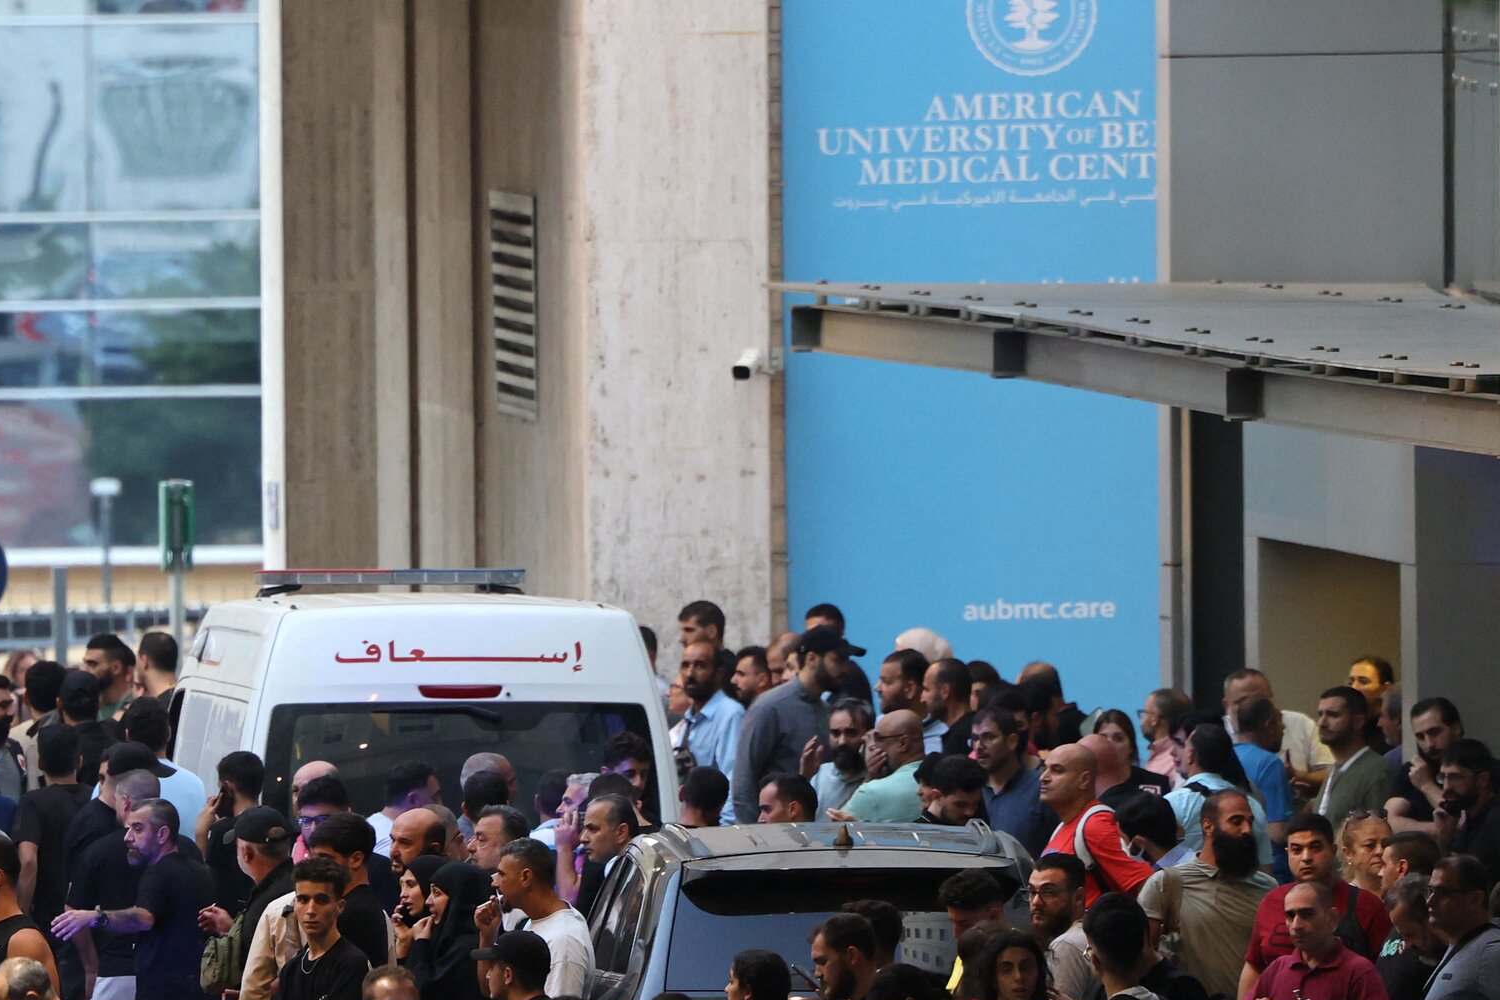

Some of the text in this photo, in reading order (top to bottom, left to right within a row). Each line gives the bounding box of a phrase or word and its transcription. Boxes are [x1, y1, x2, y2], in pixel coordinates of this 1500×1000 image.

[923, 90, 1141, 122] AMERICAN
[816, 122, 1064, 156] UNIVERSITY
[1066, 127, 1095, 145] OF
[858, 154, 1039, 186] MEDICAL
[963, 598, 1116, 621] aubmc.care
[334, 640, 583, 673] إسعاف
